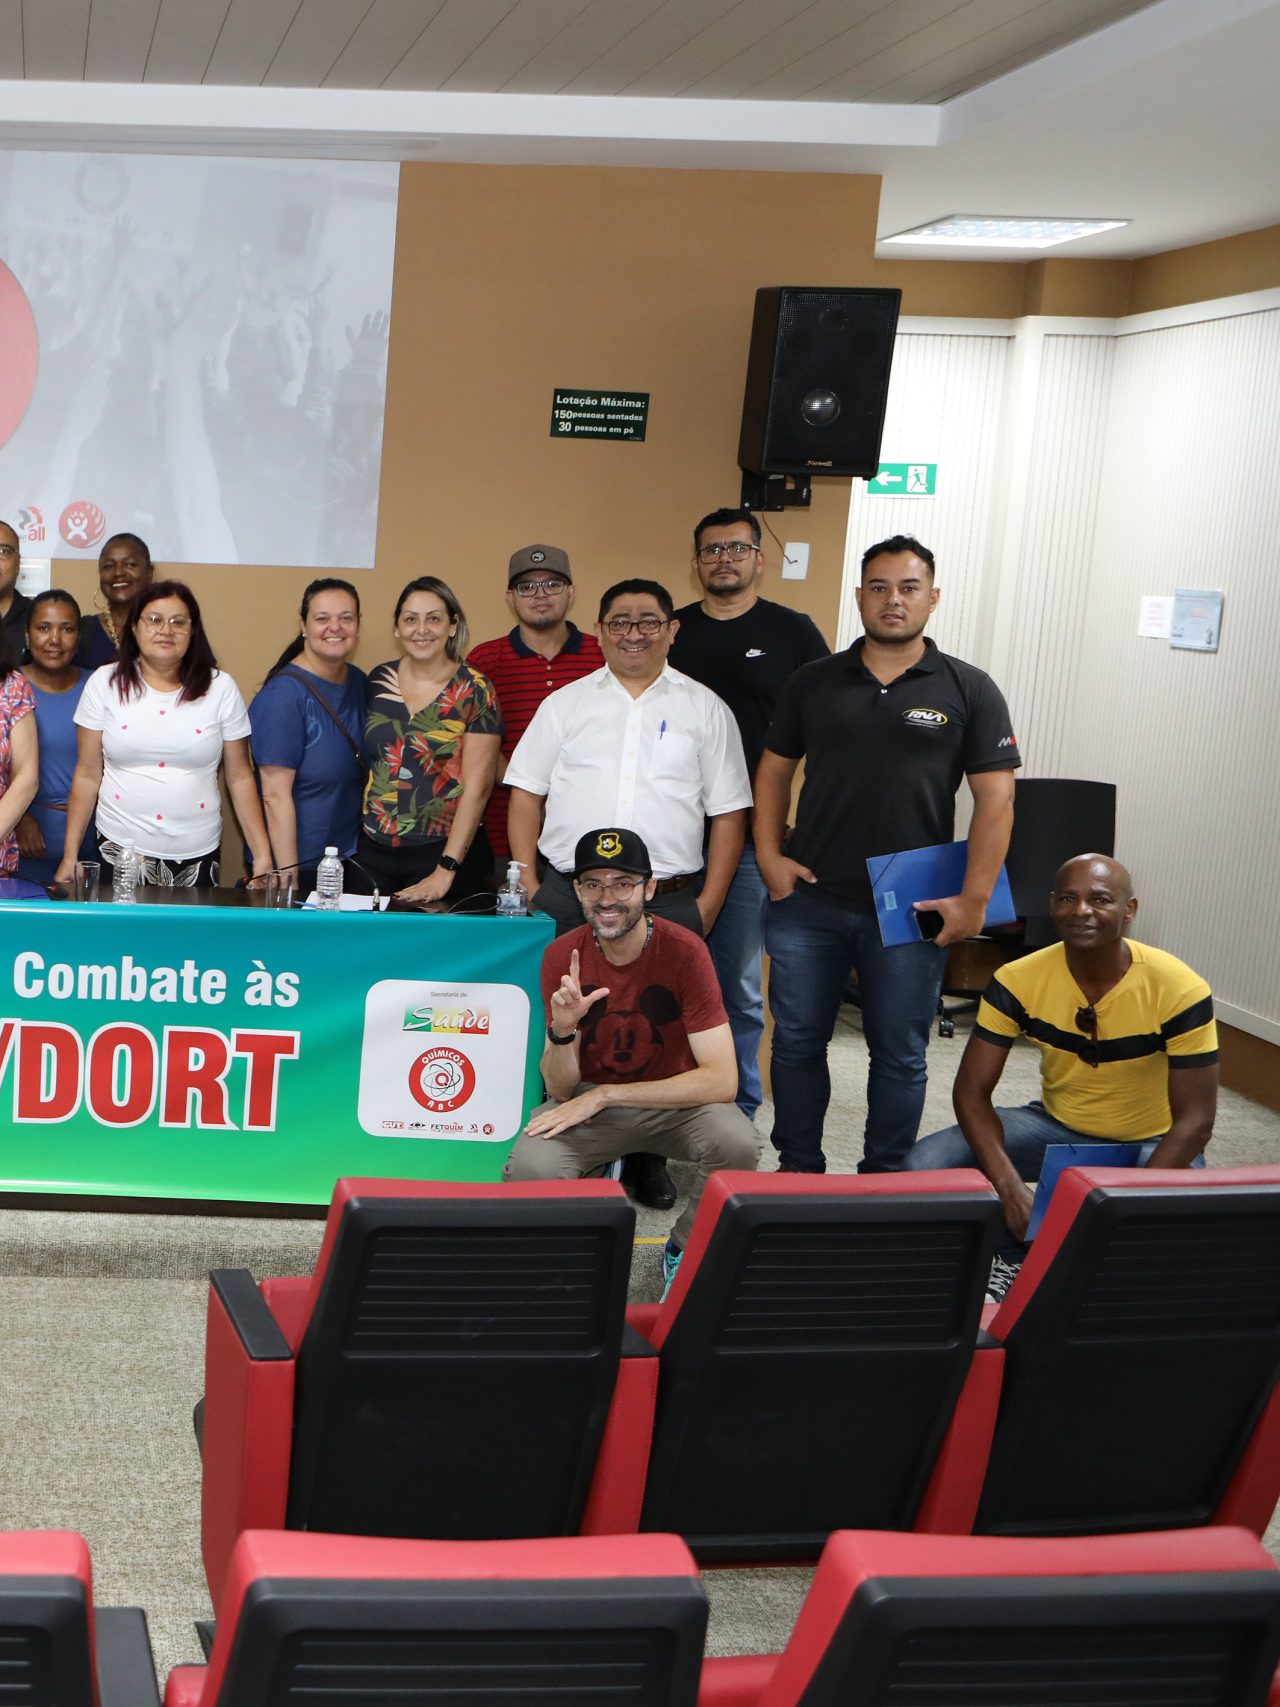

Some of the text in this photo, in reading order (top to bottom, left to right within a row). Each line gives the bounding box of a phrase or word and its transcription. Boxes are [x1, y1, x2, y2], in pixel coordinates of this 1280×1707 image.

[556, 395, 645, 408] Lotação Máxima:
[606, 413, 644, 421] sentadas
[558, 422, 572, 432] 30
[574, 425, 607, 433] pessoas
[623, 426, 634, 435] pé
[13, 951, 227, 1005] Combate
[244, 960, 300, 1008] às
[403, 1006, 489, 1031] Saúde
[421, 1048, 465, 1066] QUÍMICOS
